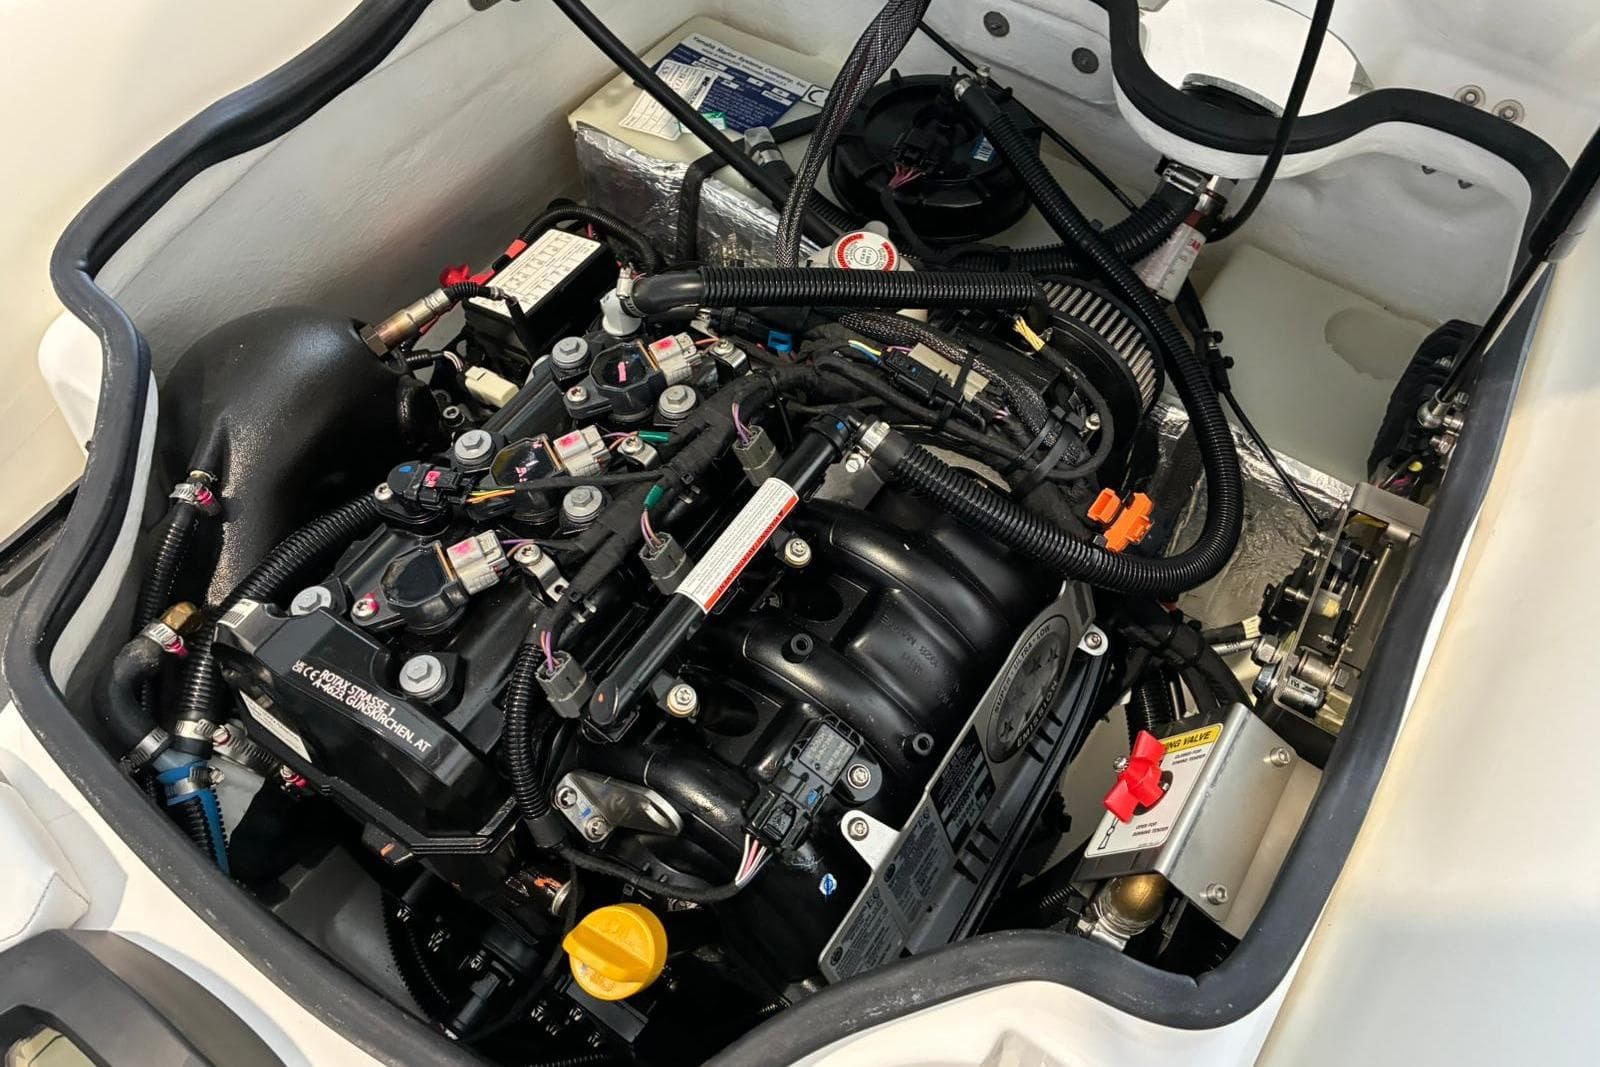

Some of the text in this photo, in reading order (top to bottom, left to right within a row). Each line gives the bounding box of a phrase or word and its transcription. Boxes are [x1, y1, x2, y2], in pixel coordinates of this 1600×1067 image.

[693, 36, 716, 50] Yamaha
[319, 669, 396, 717] ROTAX STRASSE 1
[994, 677, 1011, 713] SUPER
[1014, 642, 1033, 671] ULTRA
[1016, 680, 1057, 747] EMISSION
[413, 738, 432, 753] AT
[1183, 731, 1212, 747] VALVE
